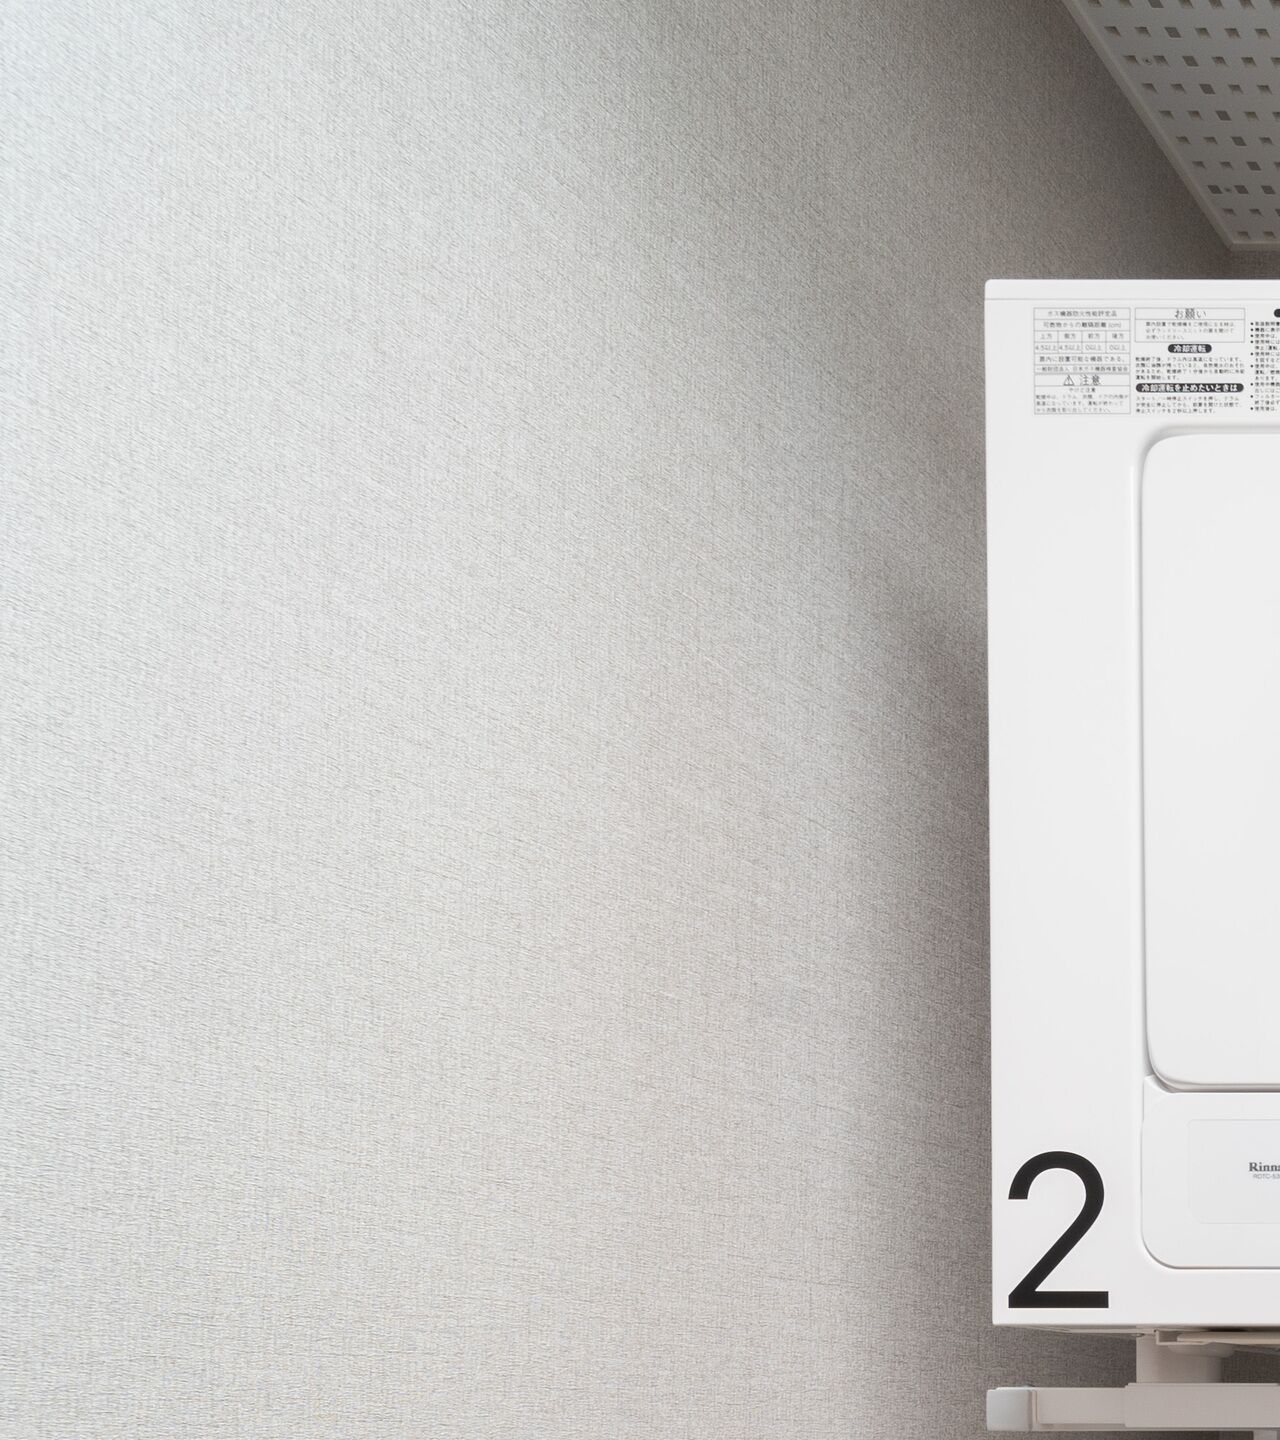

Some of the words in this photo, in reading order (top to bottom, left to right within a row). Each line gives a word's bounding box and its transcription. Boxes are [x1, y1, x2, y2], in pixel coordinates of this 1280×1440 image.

[1174, 307, 1208, 320] お願い
[1174, 344, 1206, 353] 冷却運転
[1141, 384, 1238, 392] 冷却運転を止めたいときは
[1008, 1151, 1109, 1308] 2
